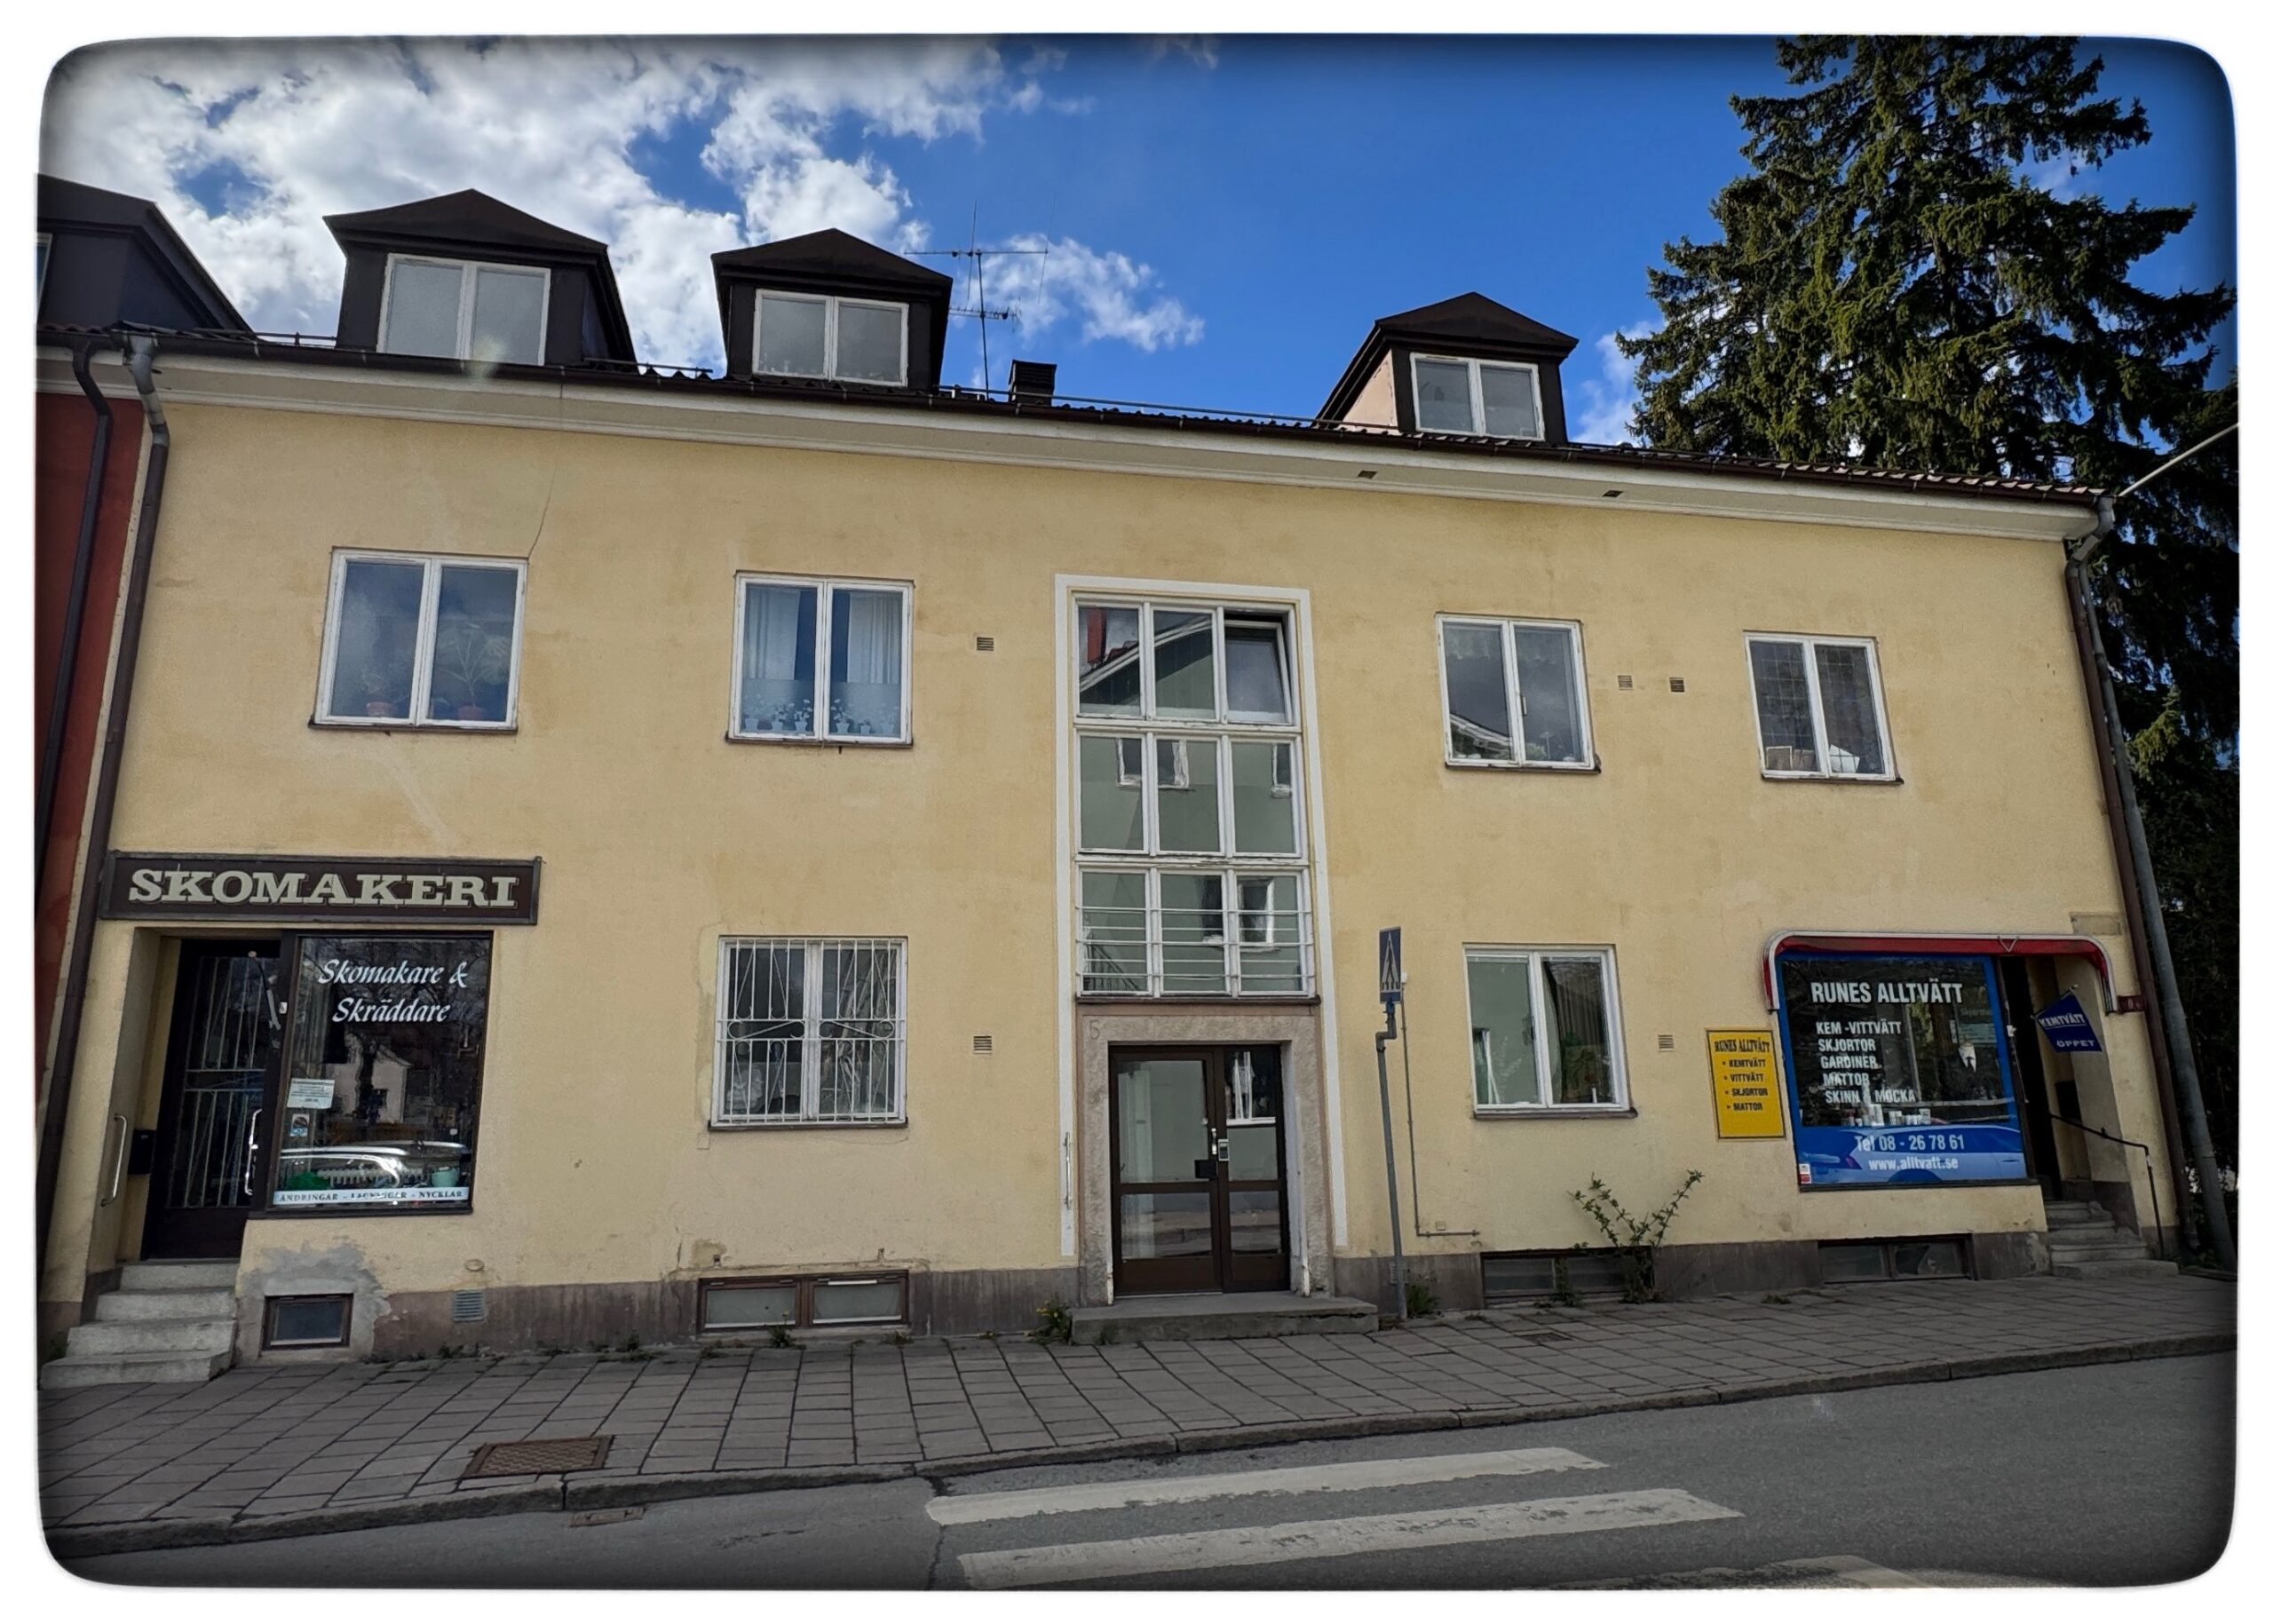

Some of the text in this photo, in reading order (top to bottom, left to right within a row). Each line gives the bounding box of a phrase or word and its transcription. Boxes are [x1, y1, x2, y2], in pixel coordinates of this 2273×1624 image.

[128, 867, 518, 909] SKOMAKERI
[318, 958, 468, 987] Skomakare &
[1810, 978, 1962, 1003] RUNES ALLTVÄTT
[332, 997, 451, 1022] Skräddare
[1089, 1019, 1101, 1040] 5
[1816, 1021, 1841, 1034] KEM
[1715, 1039, 1738, 1052] RUNES
[1818, 1038, 1876, 1052] SKJORTOR
[1729, 1058, 1766, 1068] KEMTVÄTT
[1820, 1055, 1878, 1069] GARDINER
[1730, 1072, 1764, 1082] VITTVÄTT
[1823, 1073, 1870, 1086] MATTOR
[1825, 1089, 1861, 1104] SKINN
[1874, 1089, 1916, 1103] MOCKA
[1733, 1102, 1763, 1111] MATTOR
[1854, 1136, 1875, 1152] Tel
[1879, 1136, 1897, 1152] 08
[1909, 1135, 1926, 1151] 26
[1928, 1134, 1946, 1150] 78
[1949, 1134, 1965, 1150] 61
[418, 1190, 463, 1199] NYCKLAR
